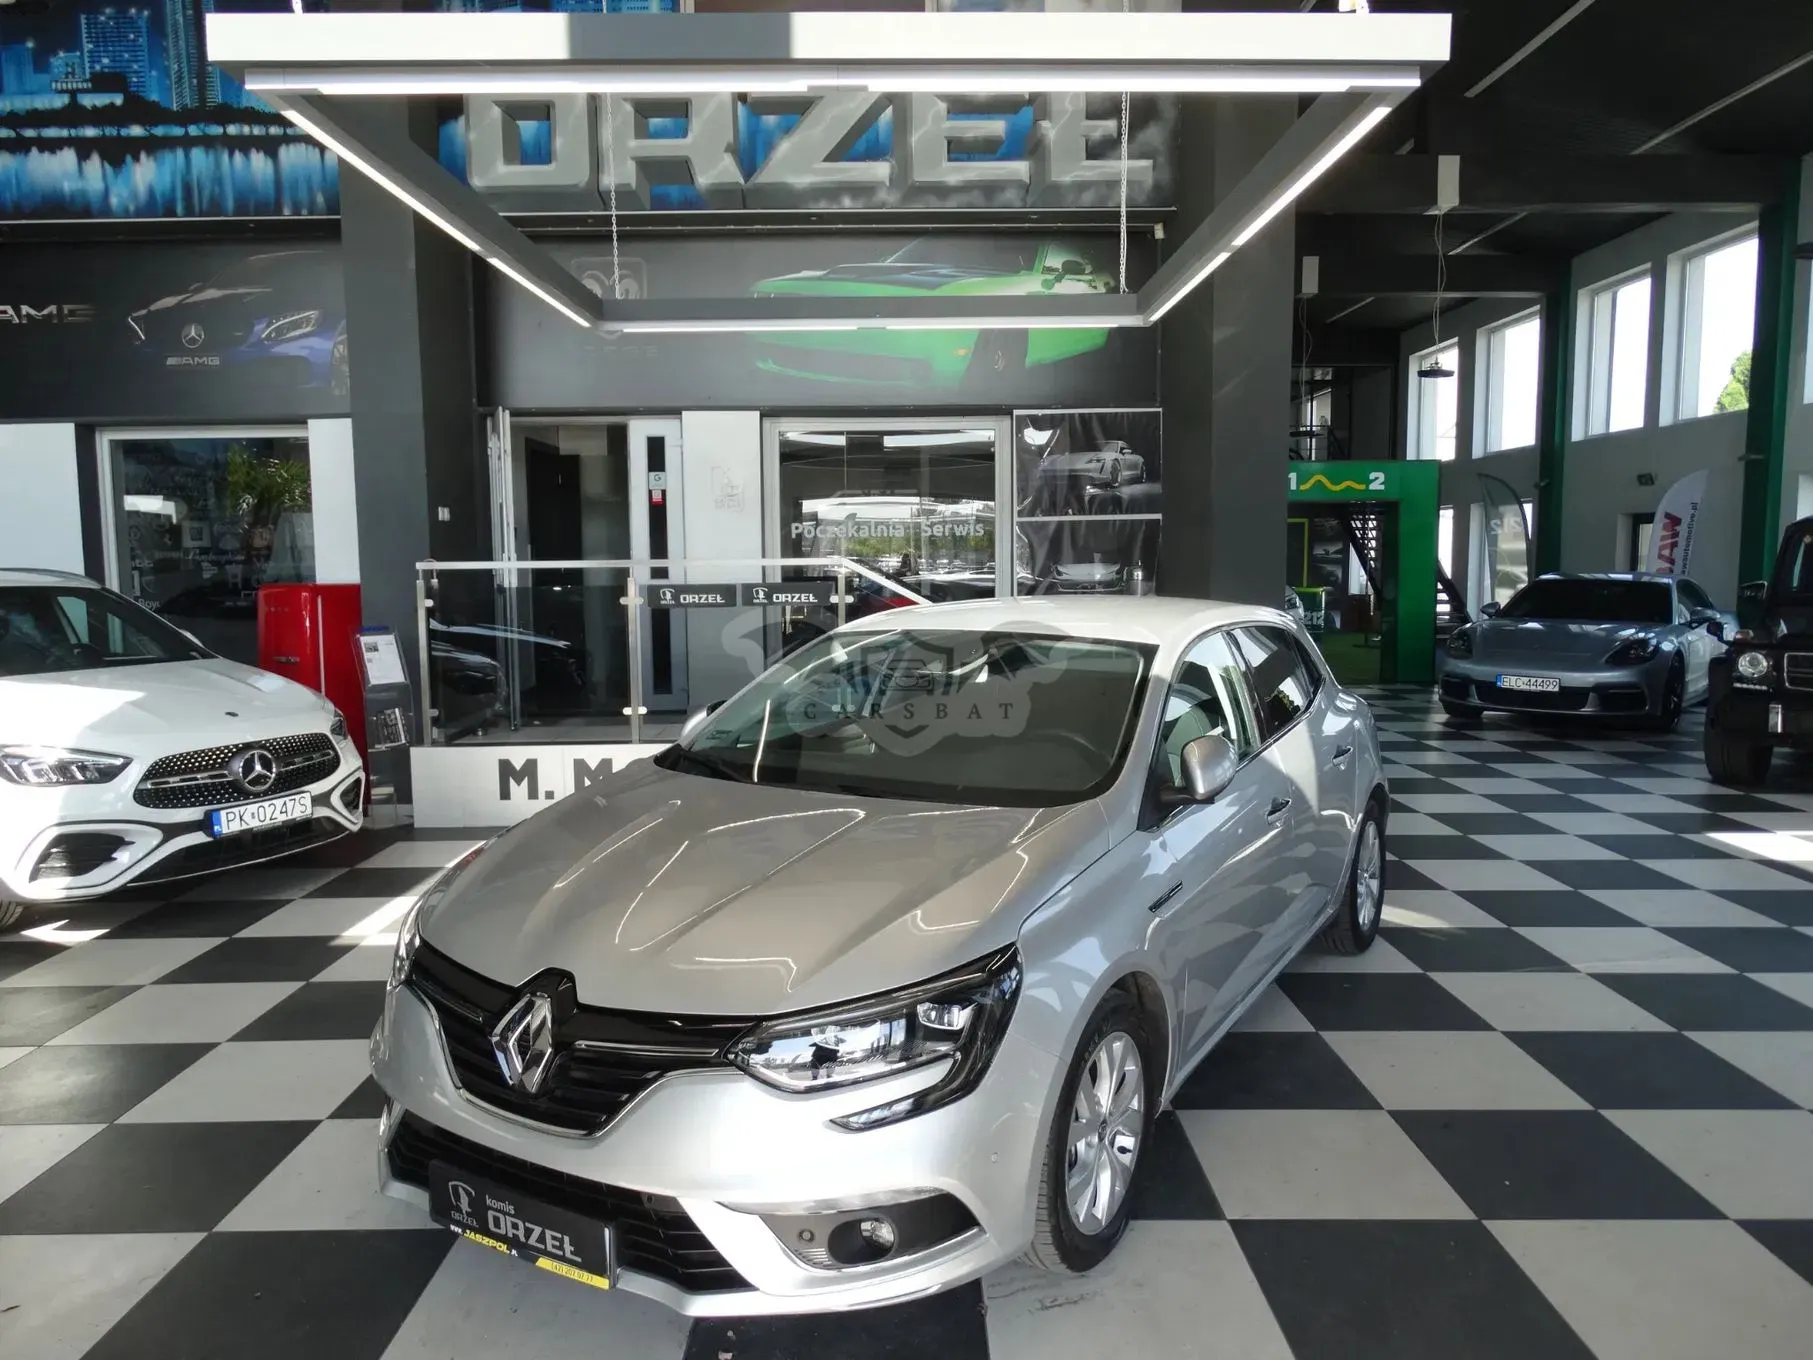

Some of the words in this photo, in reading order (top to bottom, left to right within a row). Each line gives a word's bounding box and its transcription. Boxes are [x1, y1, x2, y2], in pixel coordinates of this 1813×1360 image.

[464, 91, 1153, 205] ORZEŁ
[1369, 472, 1385, 490] 2
[791, 520, 905, 539] Poczekalnia
[921, 521, 985, 537] Serwis
[680, 594, 725, 604] ORZEŁ
[773, 593, 818, 603] ORZEŁ
[225, 808, 250, 830] PK
[256, 796, 308, 823] 0247S
[485, 1194, 515, 1215] komis
[487, 1210, 582, 1262] ORZEŁ
